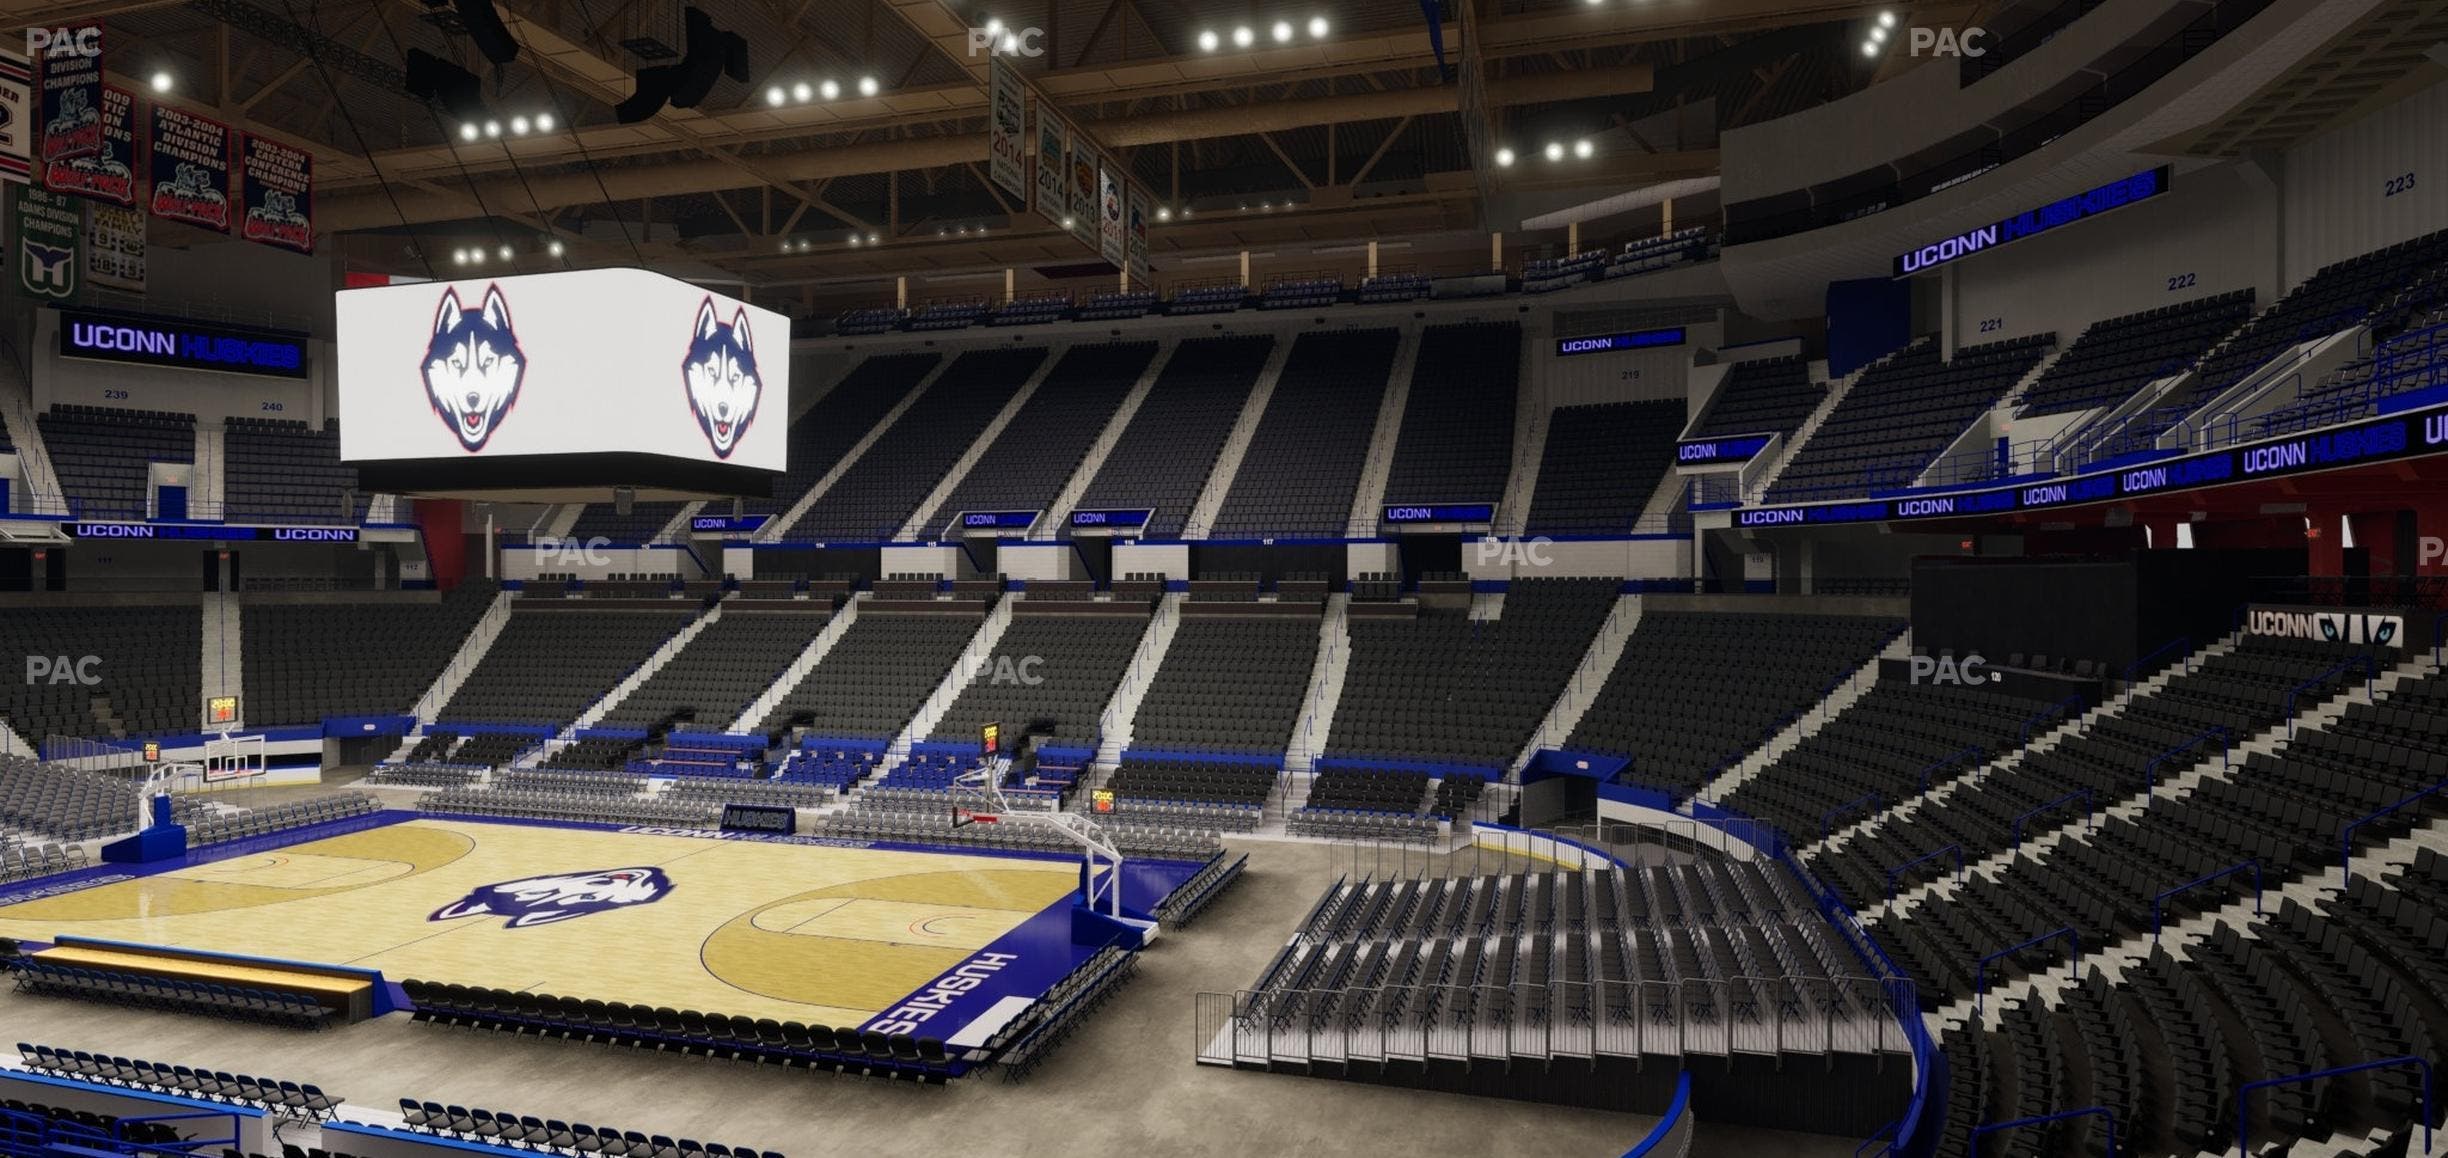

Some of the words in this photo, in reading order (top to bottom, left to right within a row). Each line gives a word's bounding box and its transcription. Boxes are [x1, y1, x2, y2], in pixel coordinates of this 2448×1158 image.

[50, 57, 92, 74] DIVISION
[43, 71, 99, 90] CHAMPIONS
[156, 107, 224, 136] 2003-2004
[158, 119, 221, 147] ATLANTIC
[162, 131, 218, 157] DIVISION
[994, 130, 1022, 168] 2014
[153, 140, 227, 171] CHAMPIONS
[255, 149, 303, 171] EASTERN
[244, 155, 310, 184] CONFERENCE
[248, 166, 308, 193] CHAMPIONS
[1039, 166, 1063, 198] 2014
[2385, 173, 2416, 197] 223
[18, 200, 46, 217] ADAMS
[46, 207, 79, 225] DIVISION
[1903, 224, 1997, 272] UCONN
[2003, 168, 2158, 241] HUSKIES
[23, 216, 73, 238] CHAMPIONS
[2168, 272, 2196, 291] 222
[1980, 317, 2002, 332] 221
[73, 323, 175, 355] UCONN
[181, 333, 300, 370] HUSKIES
[1562, 338, 1612, 352] UCONN
[1621, 370, 1640, 380] 219
[105, 389, 128, 400] 239
[261, 401, 283, 412] 240
[1679, 443, 1717, 460] UCONN
[2243, 441, 2306, 474] UCONN
[2123, 468, 2167, 492] UCONN
[2023, 485, 2067, 505] UCONN
[1388, 508, 1431, 519] UCONN
[1741, 509, 1804, 524] UCONN
[1898, 498, 1954, 516] UCONN
[693, 519, 726, 529] UCONN
[965, 515, 996, 525] UCONN
[1074, 512, 1106, 523] UCONN
[76, 524, 154, 537] UCONN
[274, 529, 354, 541] UCONN
[2250, 610, 2314, 640] UCONN
[618, 825, 737, 839] UCONN
[867, 952, 1018, 1037] HUSKIES
